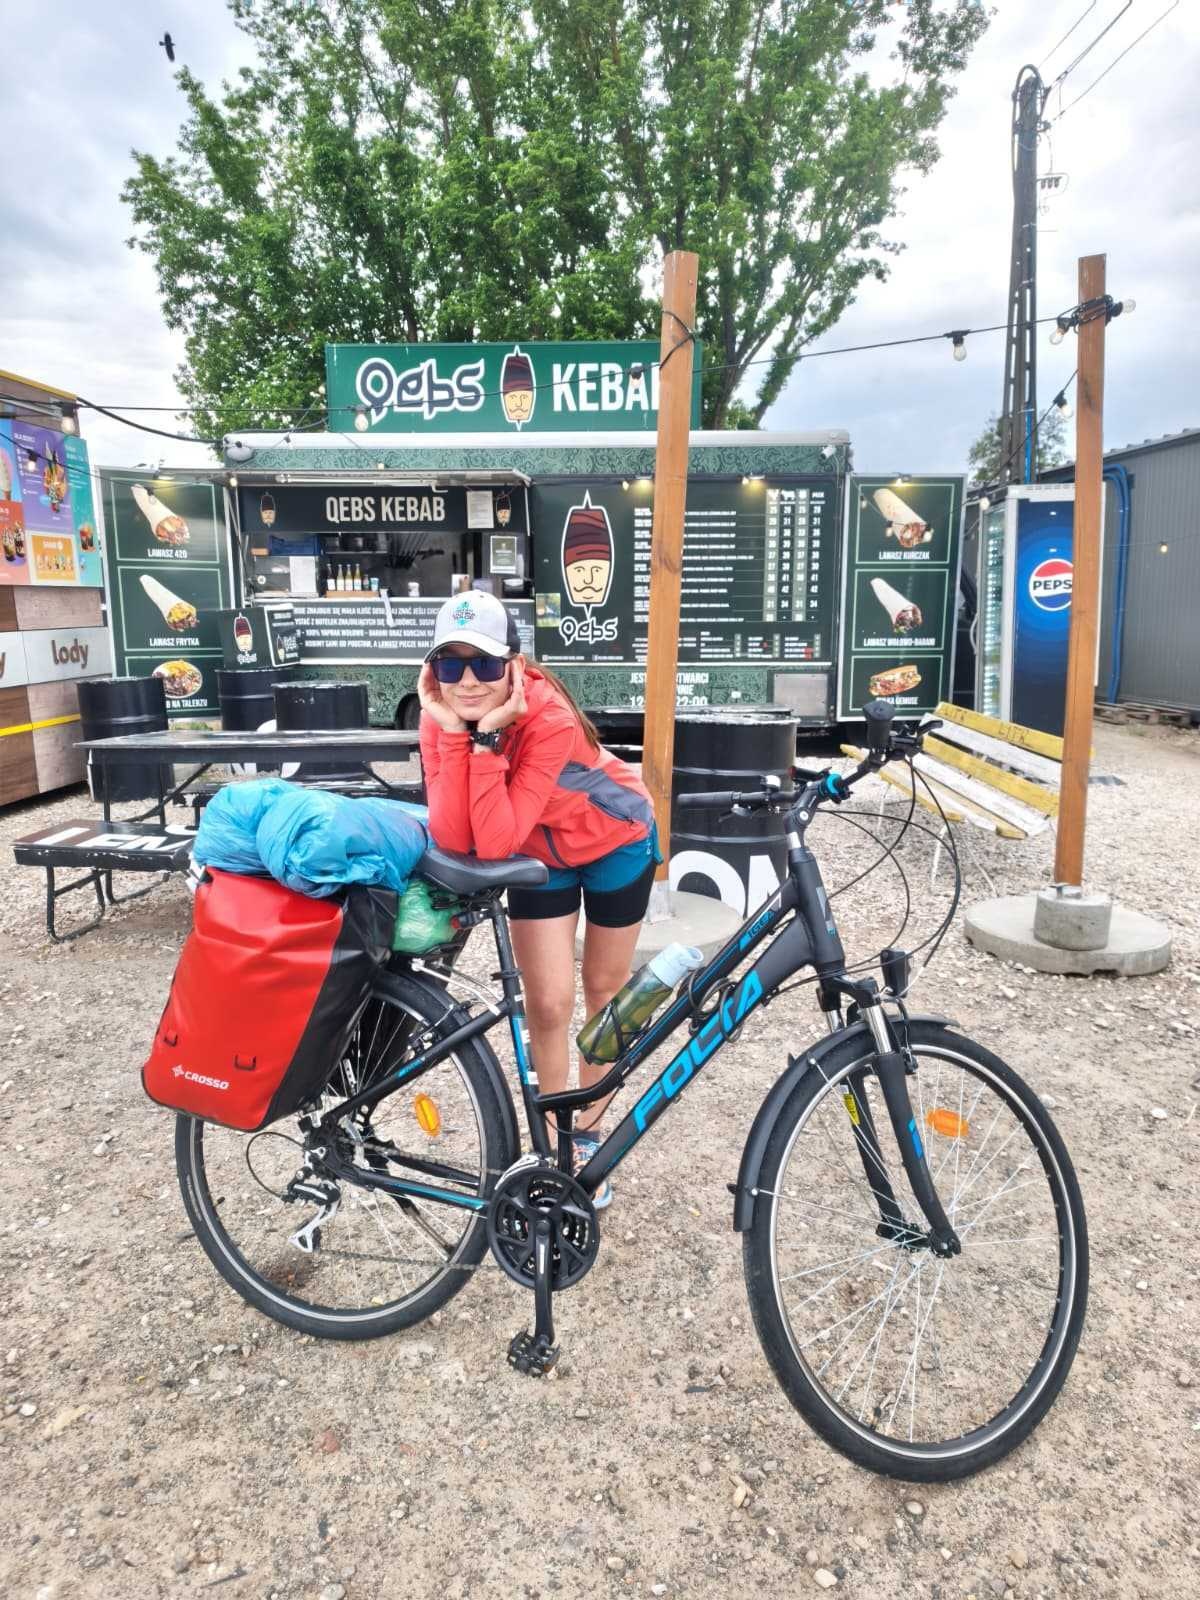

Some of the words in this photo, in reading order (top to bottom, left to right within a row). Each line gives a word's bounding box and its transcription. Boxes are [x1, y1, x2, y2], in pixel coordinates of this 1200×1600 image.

[356, 357, 484, 426] Qebs
[326, 496, 376, 523] QEBS
[381, 496, 446, 522] KEBAB
[1033, 579, 1073, 590] PEPS
[51, 638, 88, 669] lody
[184, 1070, 230, 1091] CROSSO
